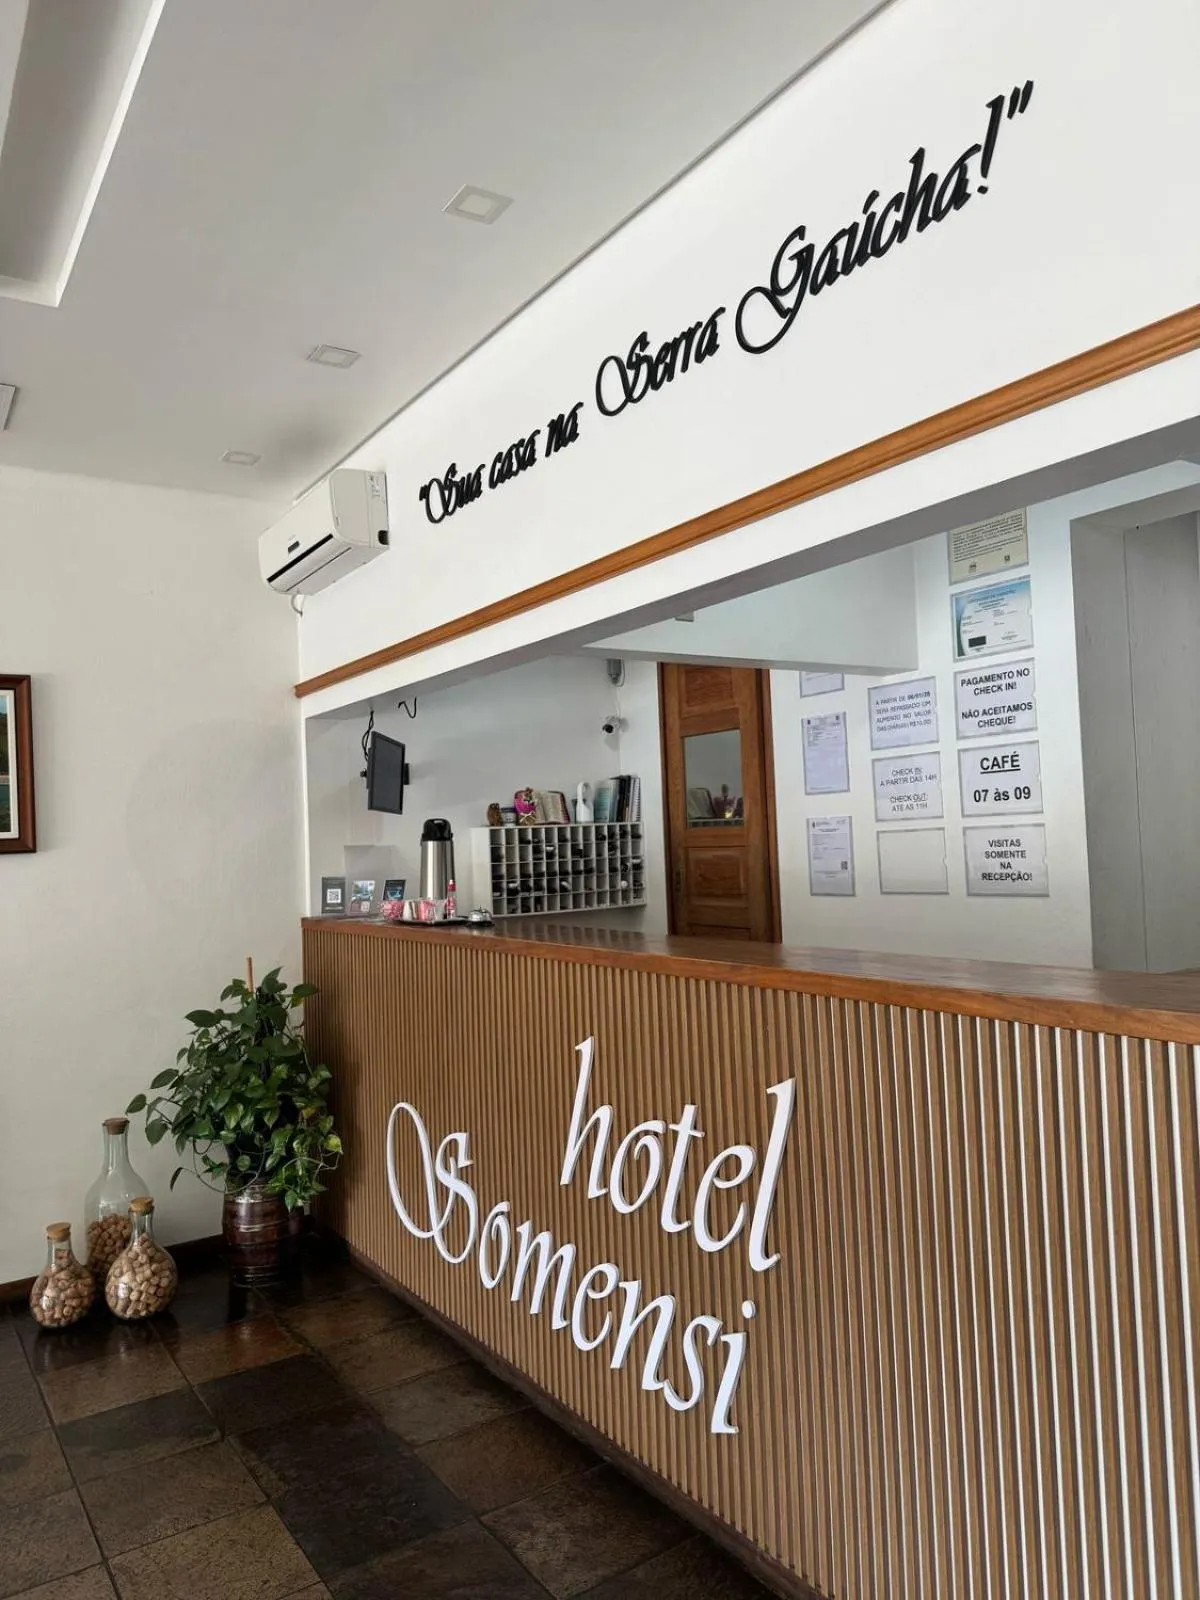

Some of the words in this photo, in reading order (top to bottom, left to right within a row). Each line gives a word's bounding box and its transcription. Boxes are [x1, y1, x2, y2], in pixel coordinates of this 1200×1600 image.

[489, 429, 541, 489] casa
[545, 401, 584, 458] na
[595, 306, 726, 417] Serra
[961, 671, 1014, 687] PAGAMENTO
[1016, 667, 1031, 678] NO
[973, 684, 1004, 696] CHECK
[1005, 681, 1017, 691] IN!
[961, 708, 980, 719] NÃO
[981, 702, 1033, 717] ACEITAMOS
[977, 715, 1016, 729] CHEQUE!
[979, 751, 1021, 772] CAFÉ
[885, 777, 909, 786] PARTIR
[909, 776, 923, 784] DAS
[925, 773, 937, 781] 14H
[891, 768, 914, 777] CHECK
[889, 794, 912, 803] CHECK
[973, 789, 990, 803] 07
[993, 787, 1010, 802] às
[1014, 786, 1031, 800] 09
[987, 839, 1022, 848] VISITAS
[984, 849, 1027, 859] SOMENTE
[999, 861, 1013, 870] NA
[981, 870, 1033, 883] RECEPÇÃO!
[559, 1035, 796, 1272] hotel
[386, 1101, 757, 1434] Somensi
